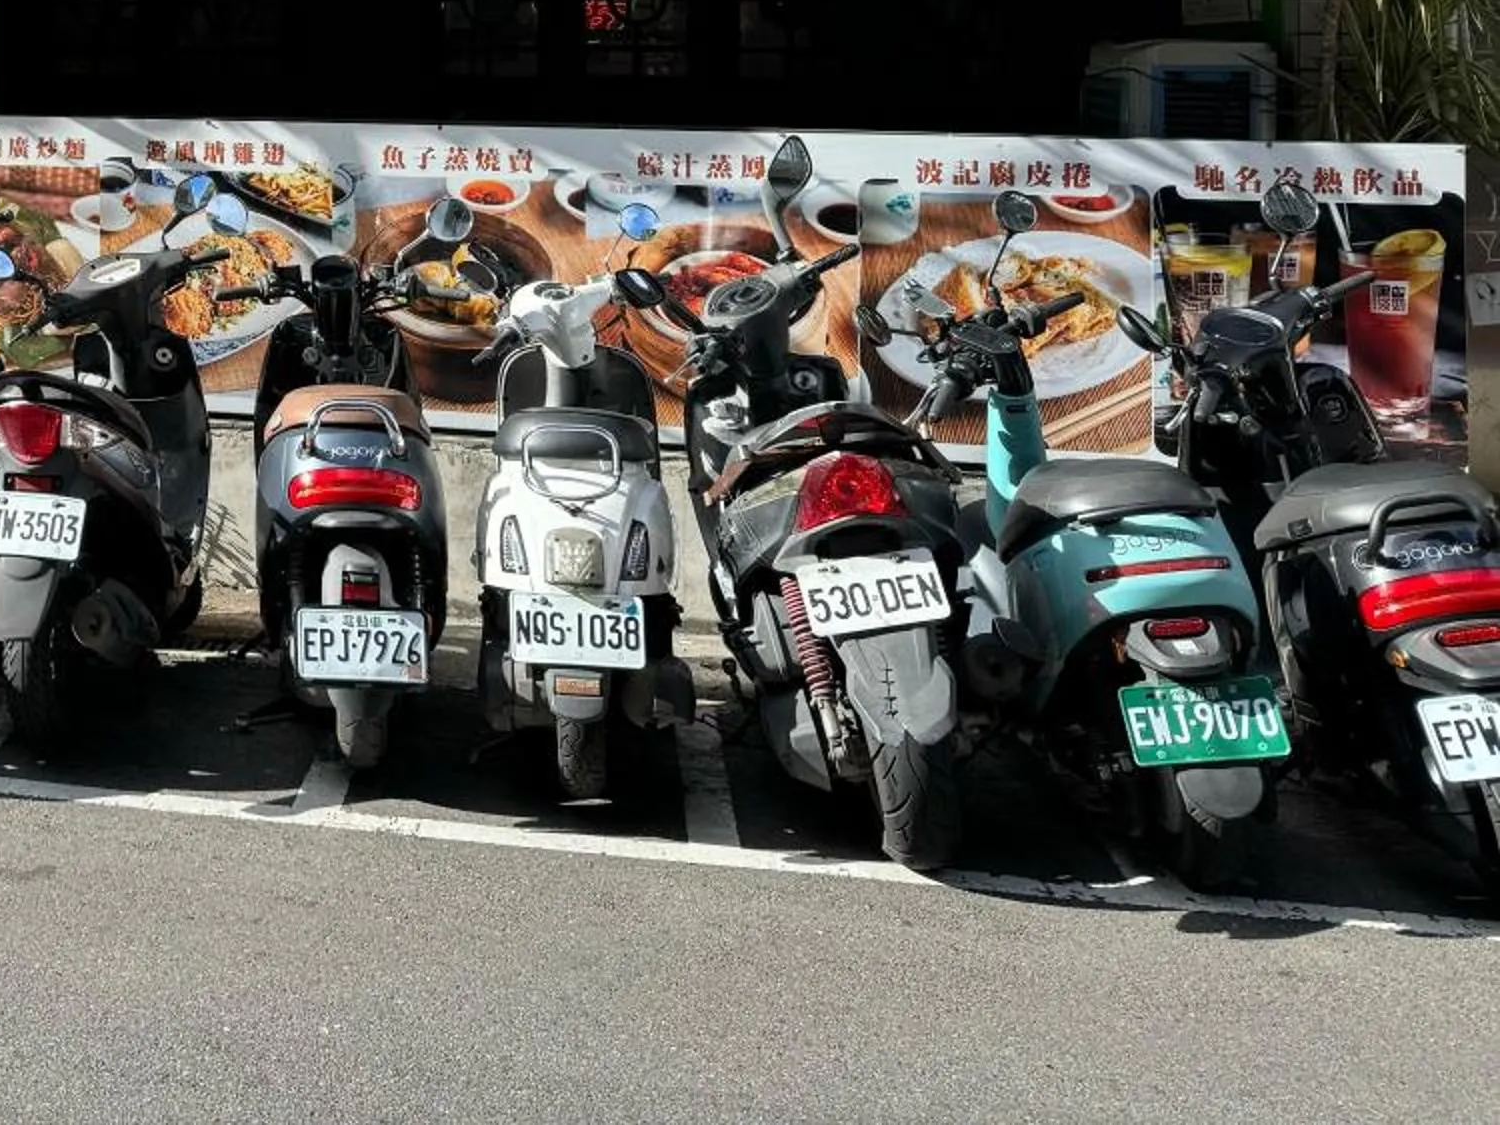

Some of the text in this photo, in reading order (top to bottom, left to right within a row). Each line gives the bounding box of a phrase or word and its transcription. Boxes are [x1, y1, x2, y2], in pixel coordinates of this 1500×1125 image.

[381, 144, 534, 174] 魚子蒸燒賣
[637, 152, 767, 181] 蠔汁蒸鳳
[1395, 540, 1474, 567] gogoro
